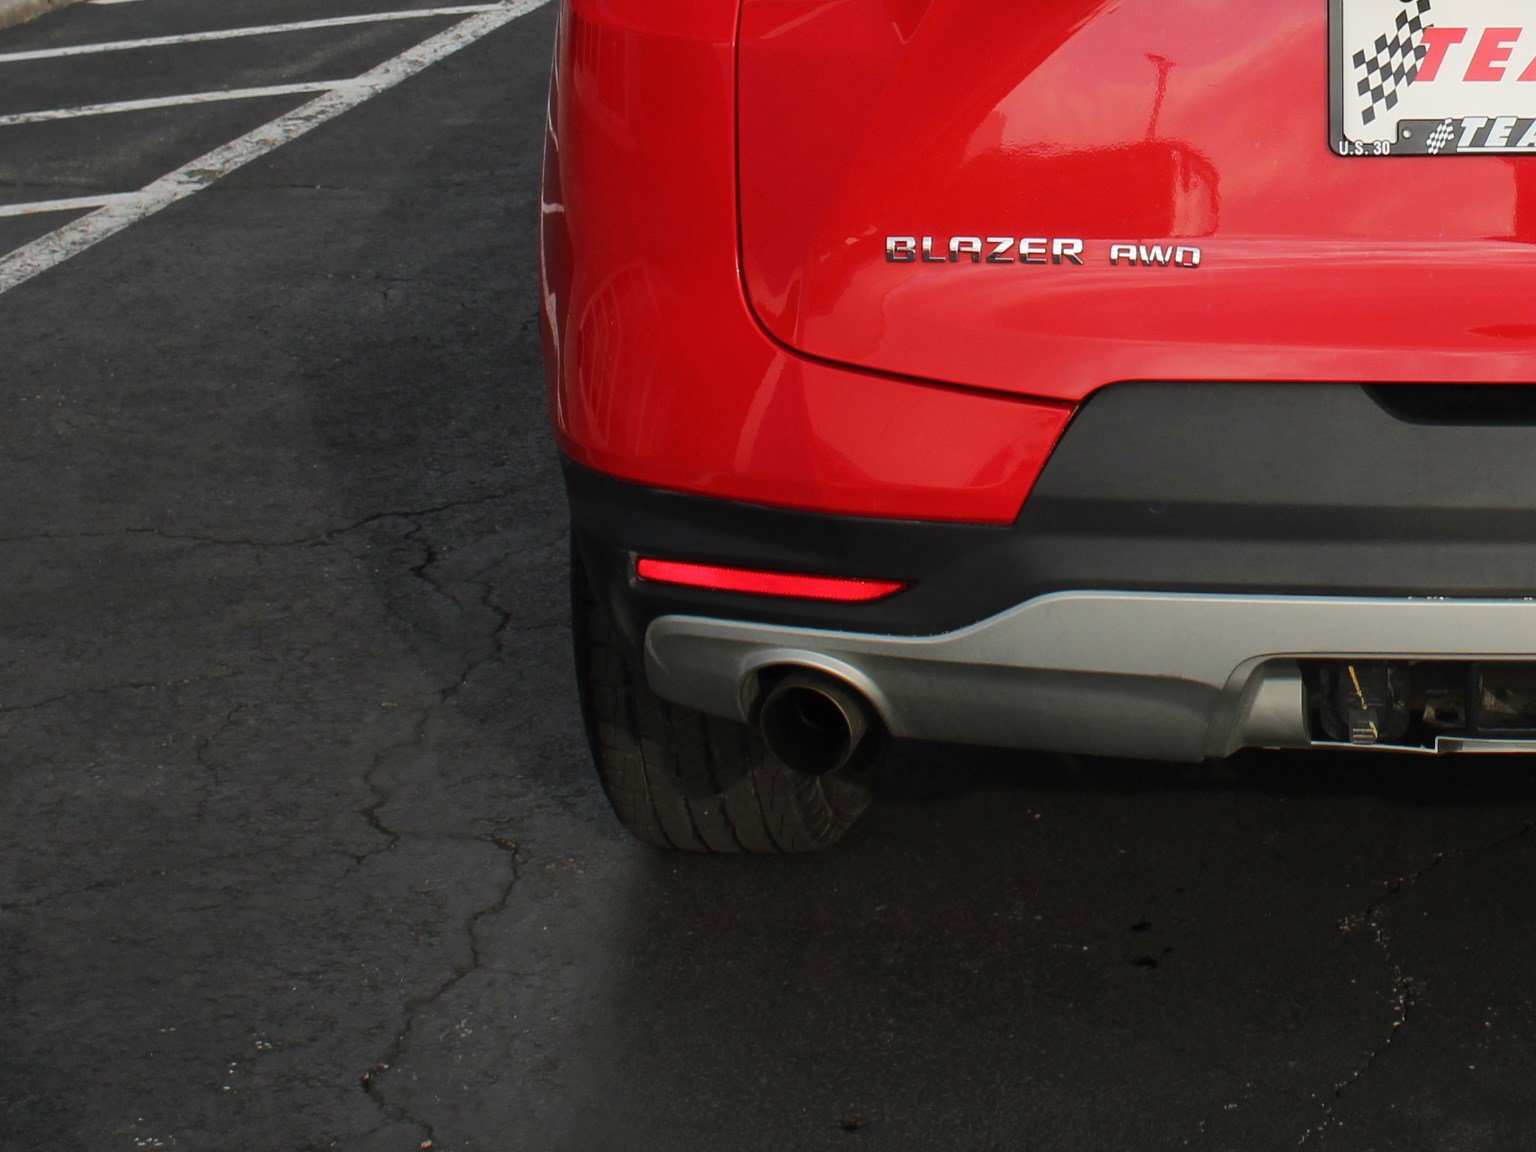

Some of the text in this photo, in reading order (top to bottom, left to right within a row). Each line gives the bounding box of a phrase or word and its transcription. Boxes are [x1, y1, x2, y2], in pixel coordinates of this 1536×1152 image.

[1338, 140, 1390, 156] U.S. 30
[886, 235, 1202, 269] BLAZER AWD
